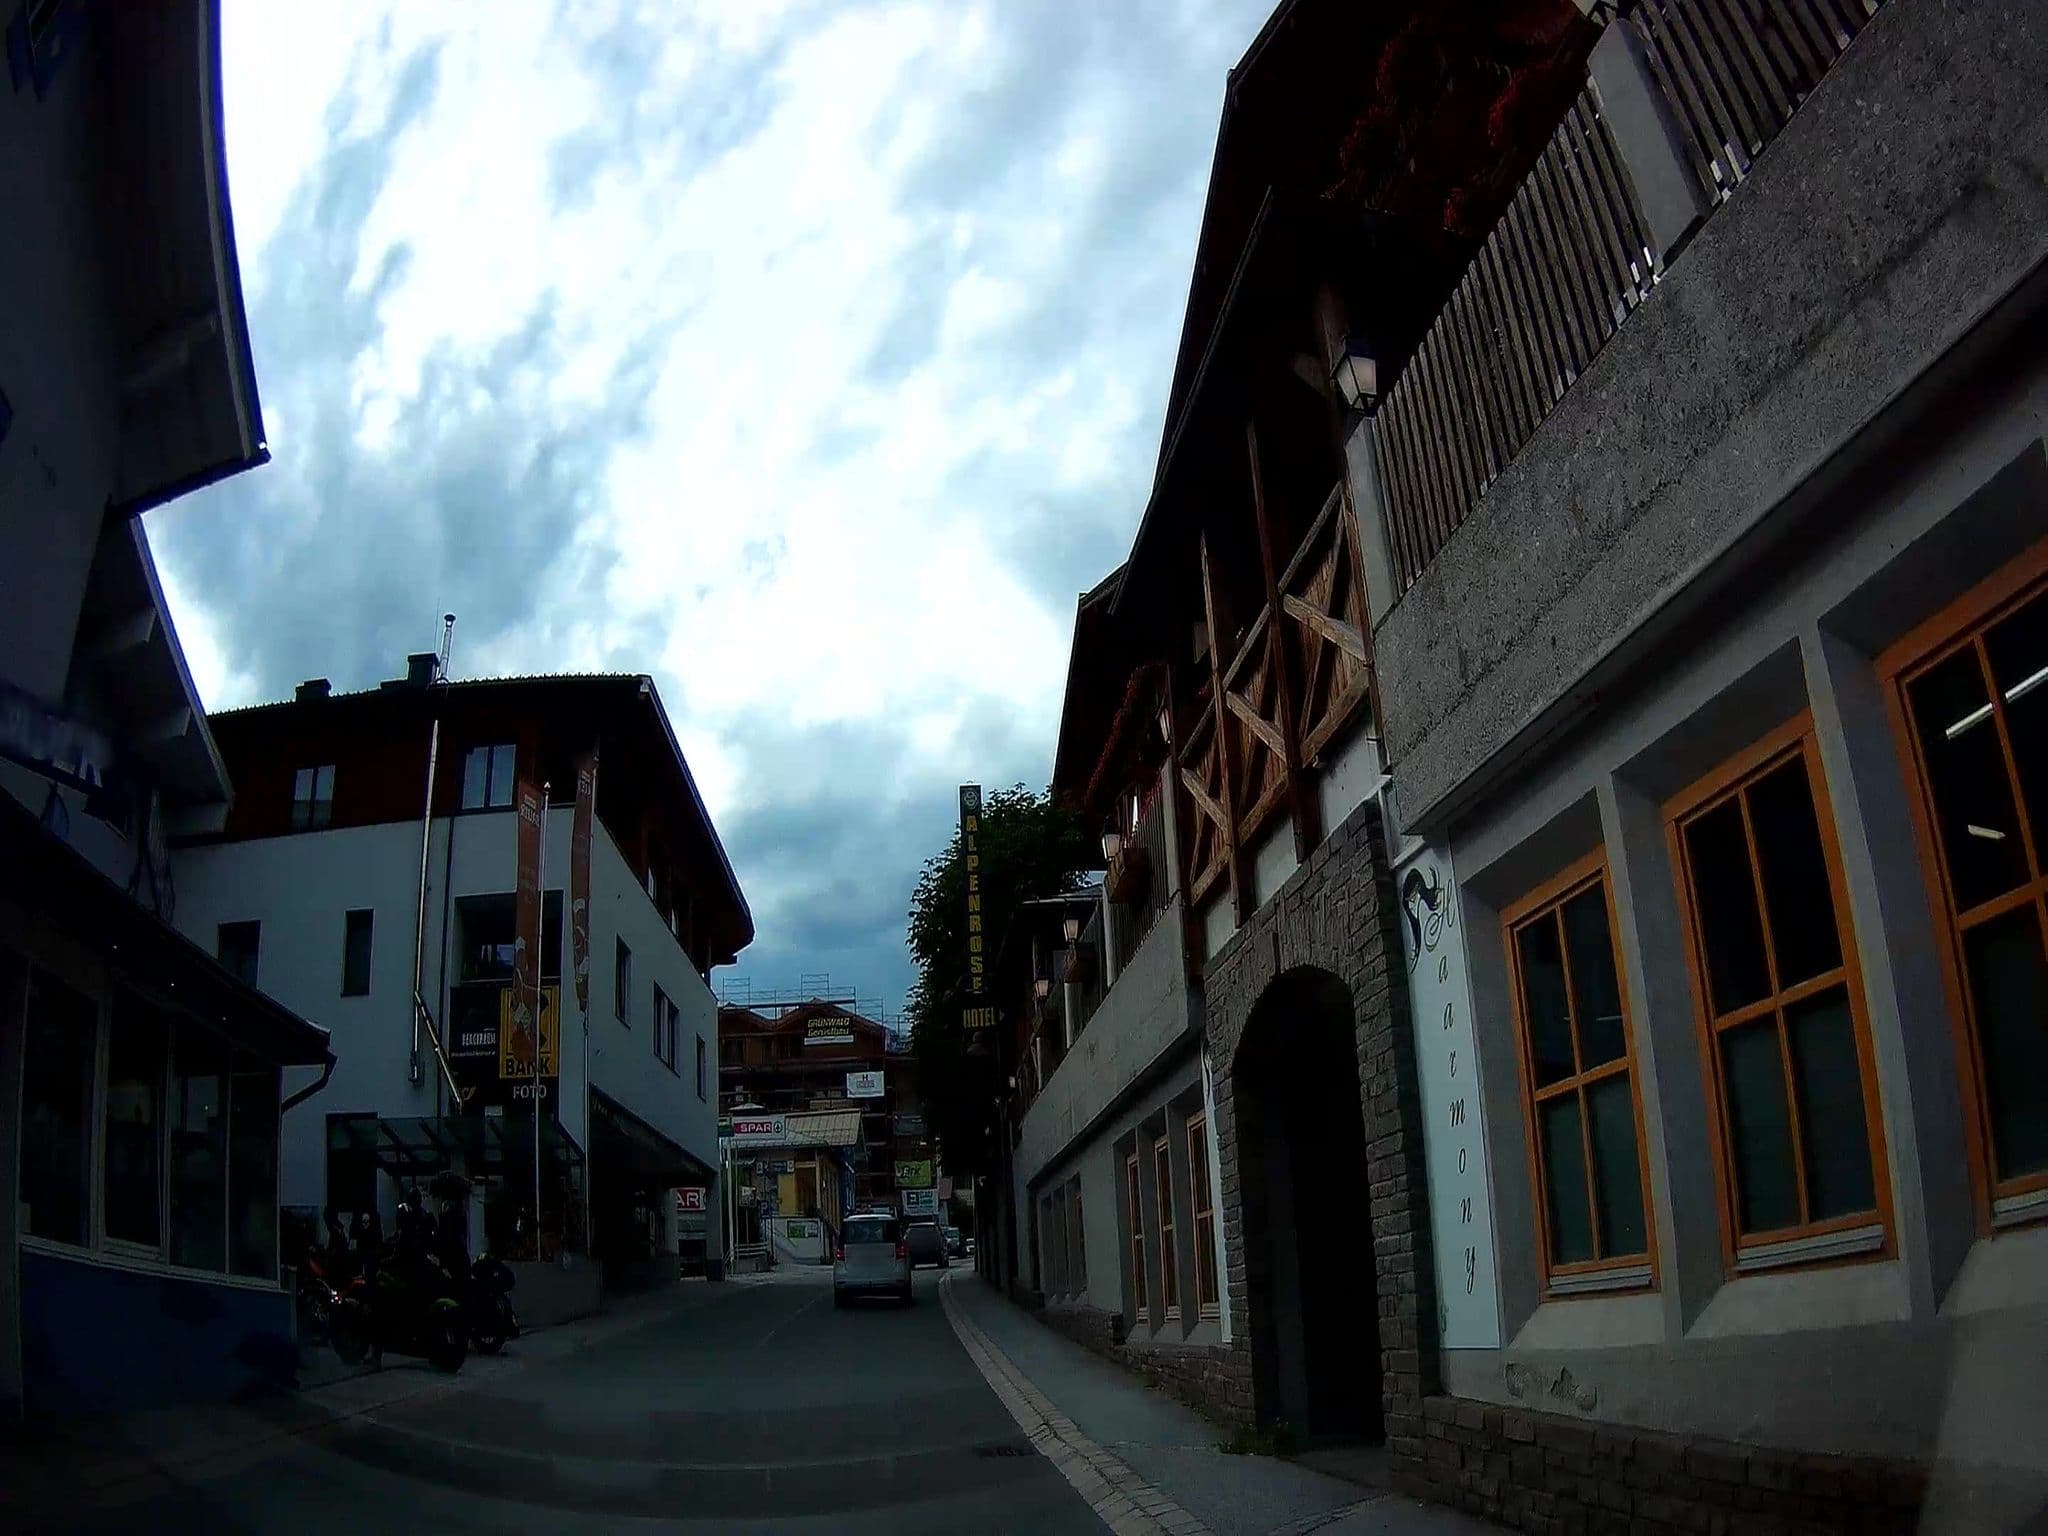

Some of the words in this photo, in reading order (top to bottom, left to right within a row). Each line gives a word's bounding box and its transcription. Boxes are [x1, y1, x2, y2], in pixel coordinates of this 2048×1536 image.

[966, 814, 983, 991] ALPENROSE
[963, 1007, 997, 1029] HOTEL
[505, 1058, 550, 1075] BANK
[512, 1084, 547, 1100] FOTO
[740, 1122, 773, 1133] SPAR
